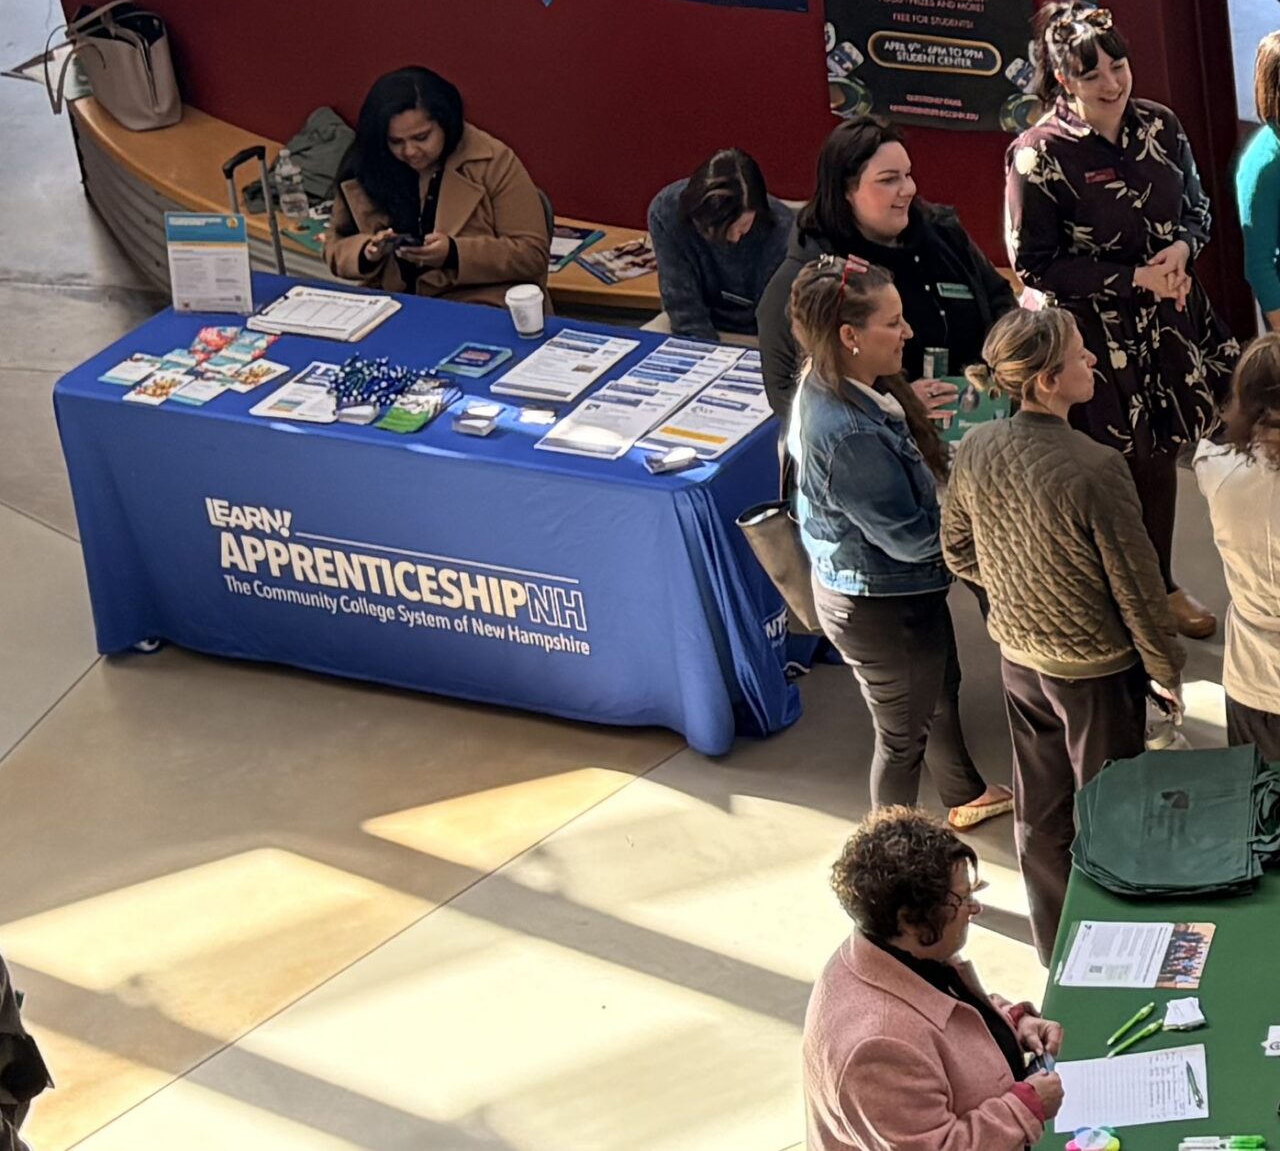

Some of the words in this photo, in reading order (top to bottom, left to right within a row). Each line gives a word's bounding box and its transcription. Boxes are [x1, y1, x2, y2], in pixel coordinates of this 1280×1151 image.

[937, 0, 956, 9] AND
[892, 12, 911, 23] FREE
[912, 14, 928, 24] FOR
[884, 41, 906, 51] APRIL
[927, 45, 947, 56] 6PM
[948, 47, 961, 57] TO
[963, 49, 984, 60] 9PM
[896, 51, 935, 64] STUDENT
[937, 56, 972, 68] CENTER
[204, 497, 293, 538] LEARN!
[223, 575, 252, 596] The
[253, 580, 337, 614] Community
[340, 595, 395, 623] College
[398, 605, 451, 632] System
[454, 615, 468, 634] of
[472, 620, 505, 641] New
[508, 625, 591, 656] Hampshire
